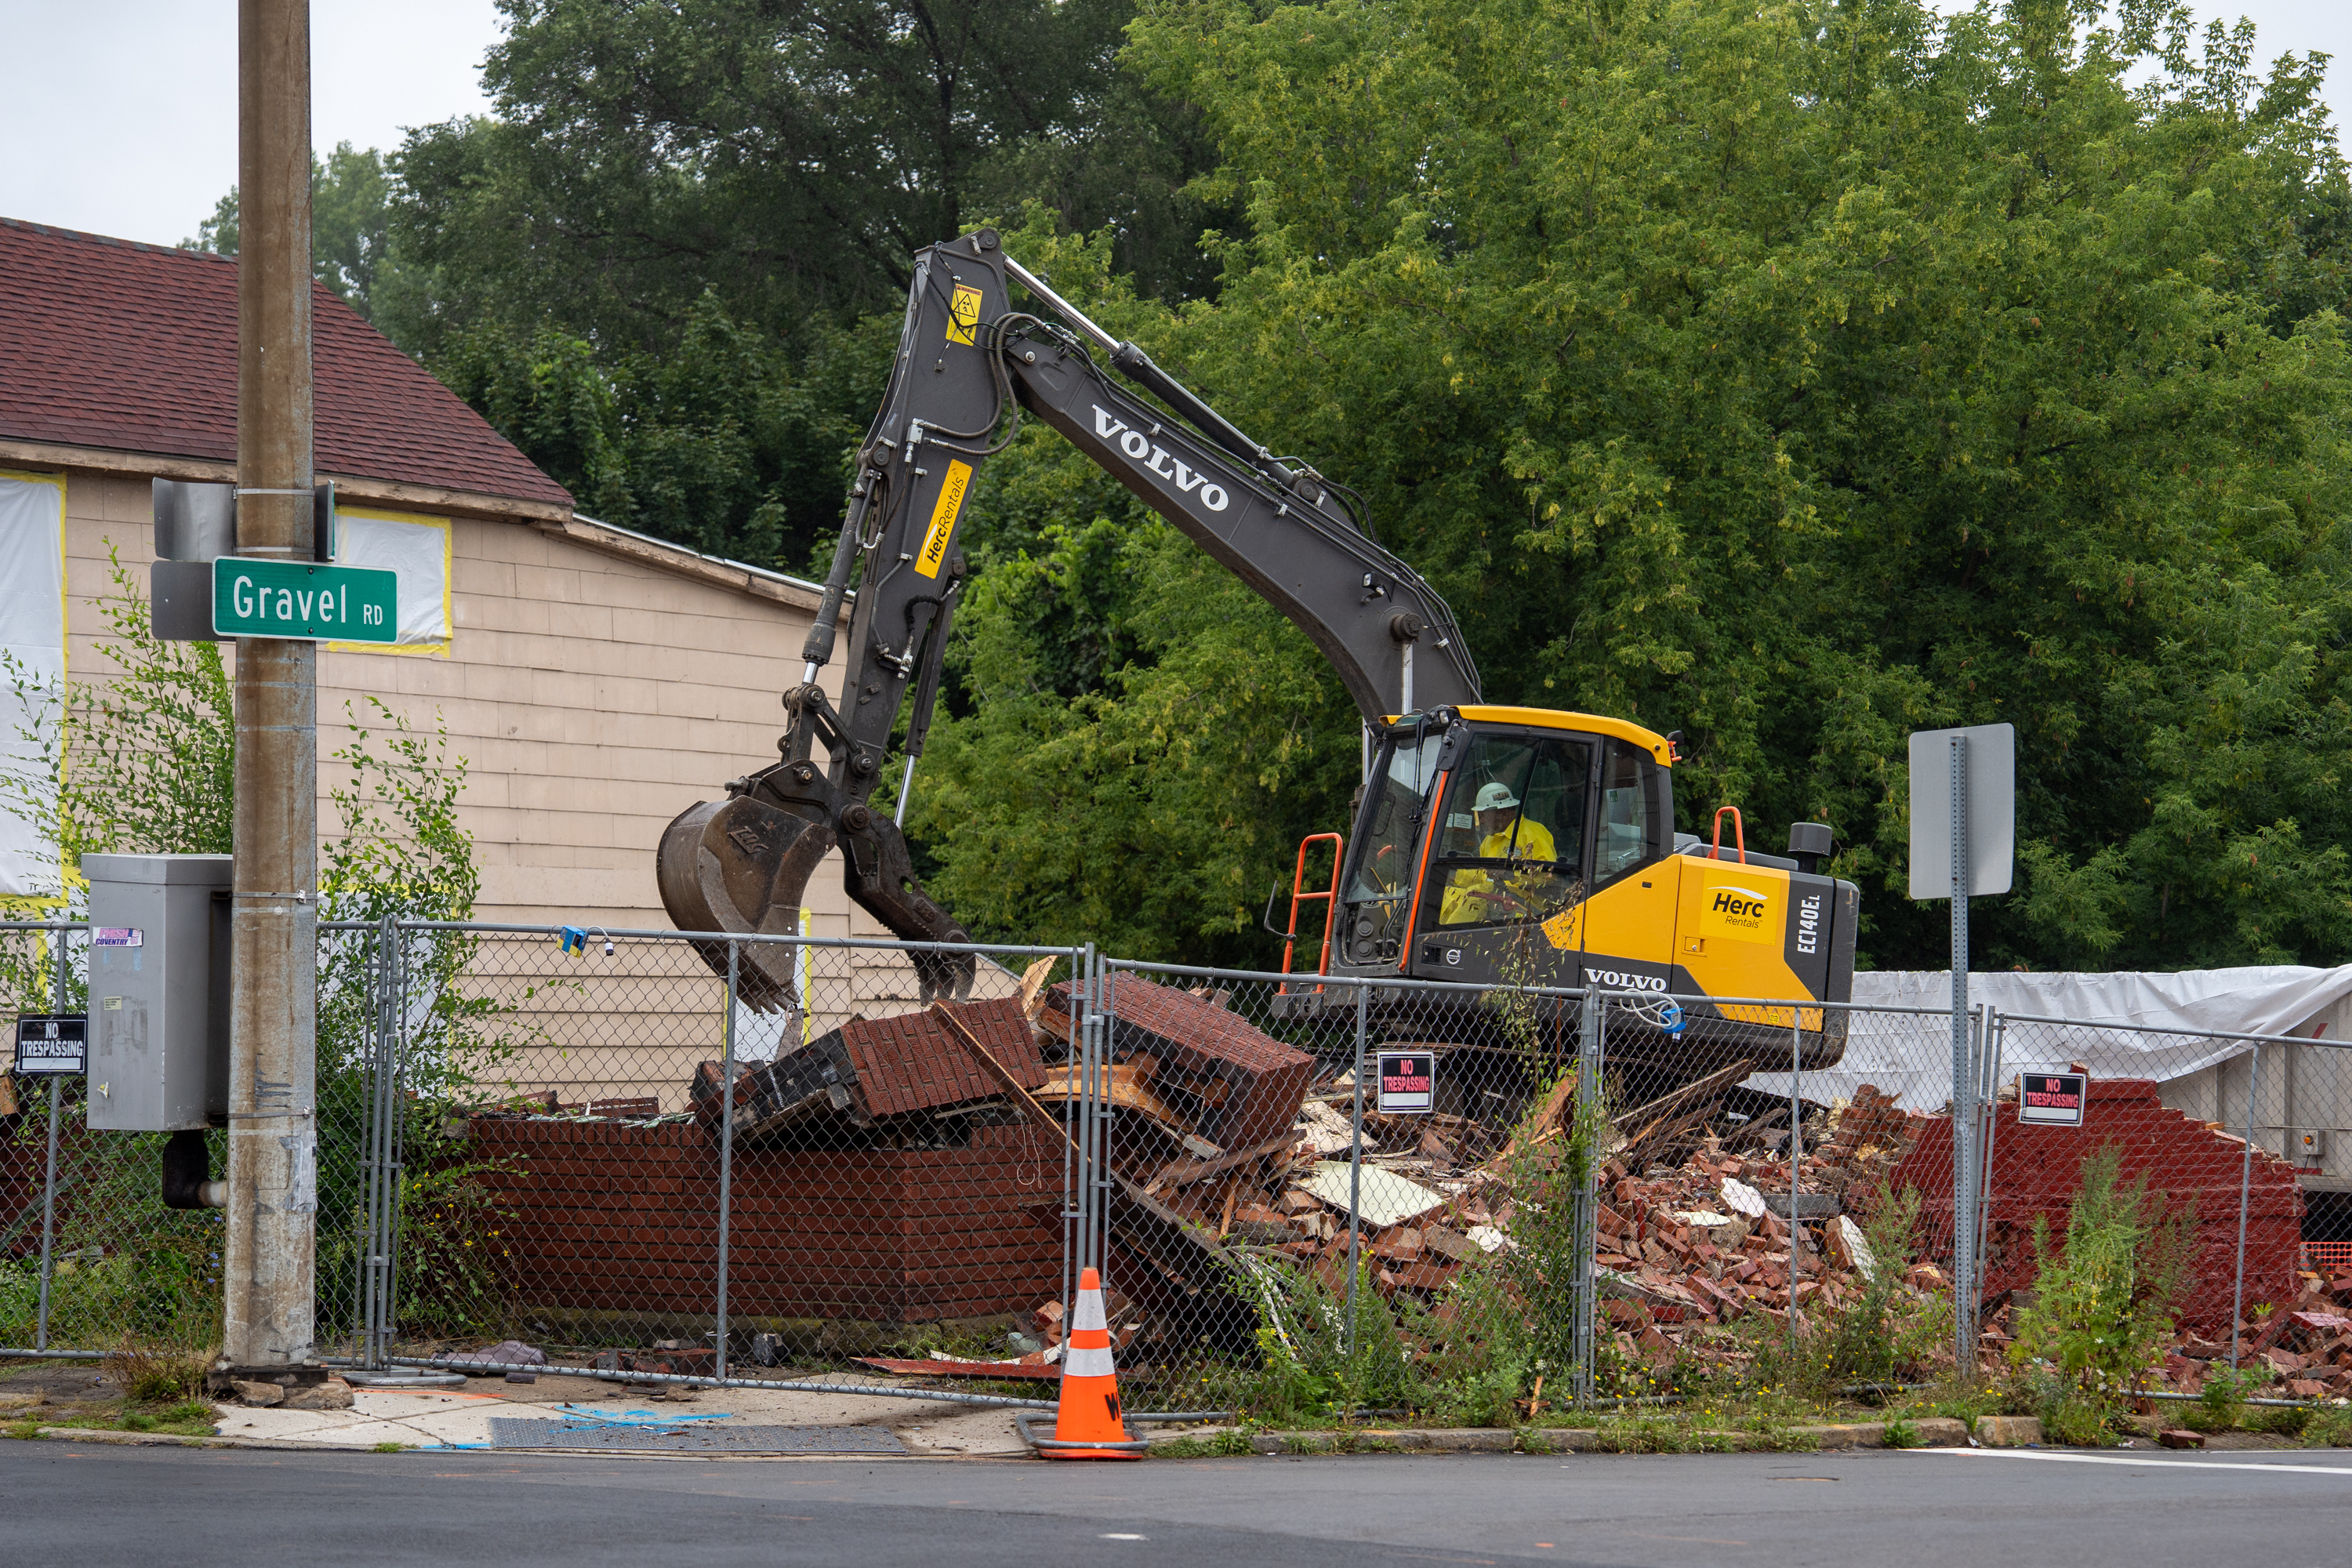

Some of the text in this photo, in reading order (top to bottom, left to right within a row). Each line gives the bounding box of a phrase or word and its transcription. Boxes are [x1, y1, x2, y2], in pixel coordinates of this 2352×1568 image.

[1092, 404, 1229, 511] VOLVO
[234, 575, 383, 626] Gravel RD
[1712, 893, 1765, 918] Herc
[99, 927, 129, 938] PHISH
[1584, 967, 1667, 992] VOLVO
[45, 1022, 59, 1039] NO
[21, 1040, 83, 1057] TRESPASSING
[1400, 1059, 1414, 1075] NO
[1383, 1076, 1430, 1091] TRESPASSING
[2045, 1078, 2061, 1092] NO
[2027, 1091, 2079, 1108] TRESPASSING
